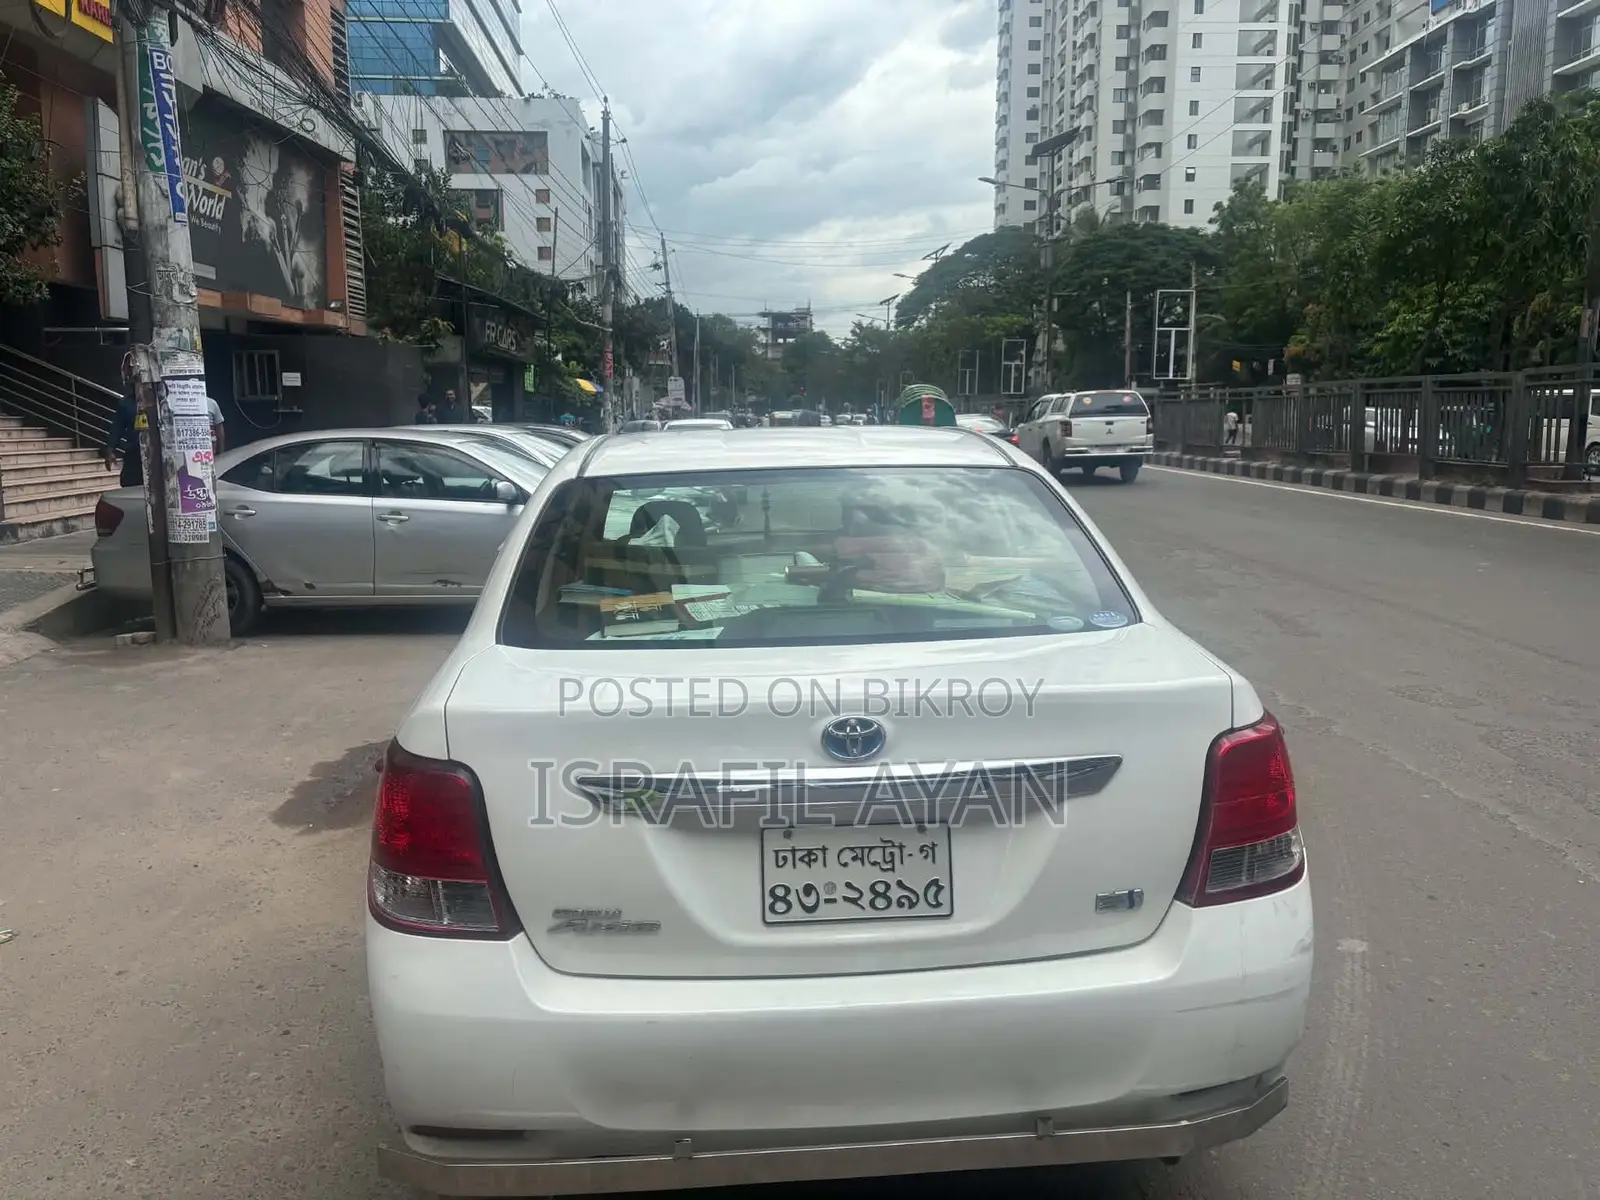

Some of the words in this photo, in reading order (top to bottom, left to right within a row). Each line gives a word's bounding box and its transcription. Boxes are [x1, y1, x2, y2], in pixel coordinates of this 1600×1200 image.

[187, 183, 226, 220] World
[773, 845, 829, 870] ঢাকা
[768, 877, 945, 915] ৪৩-২৪৯৫
